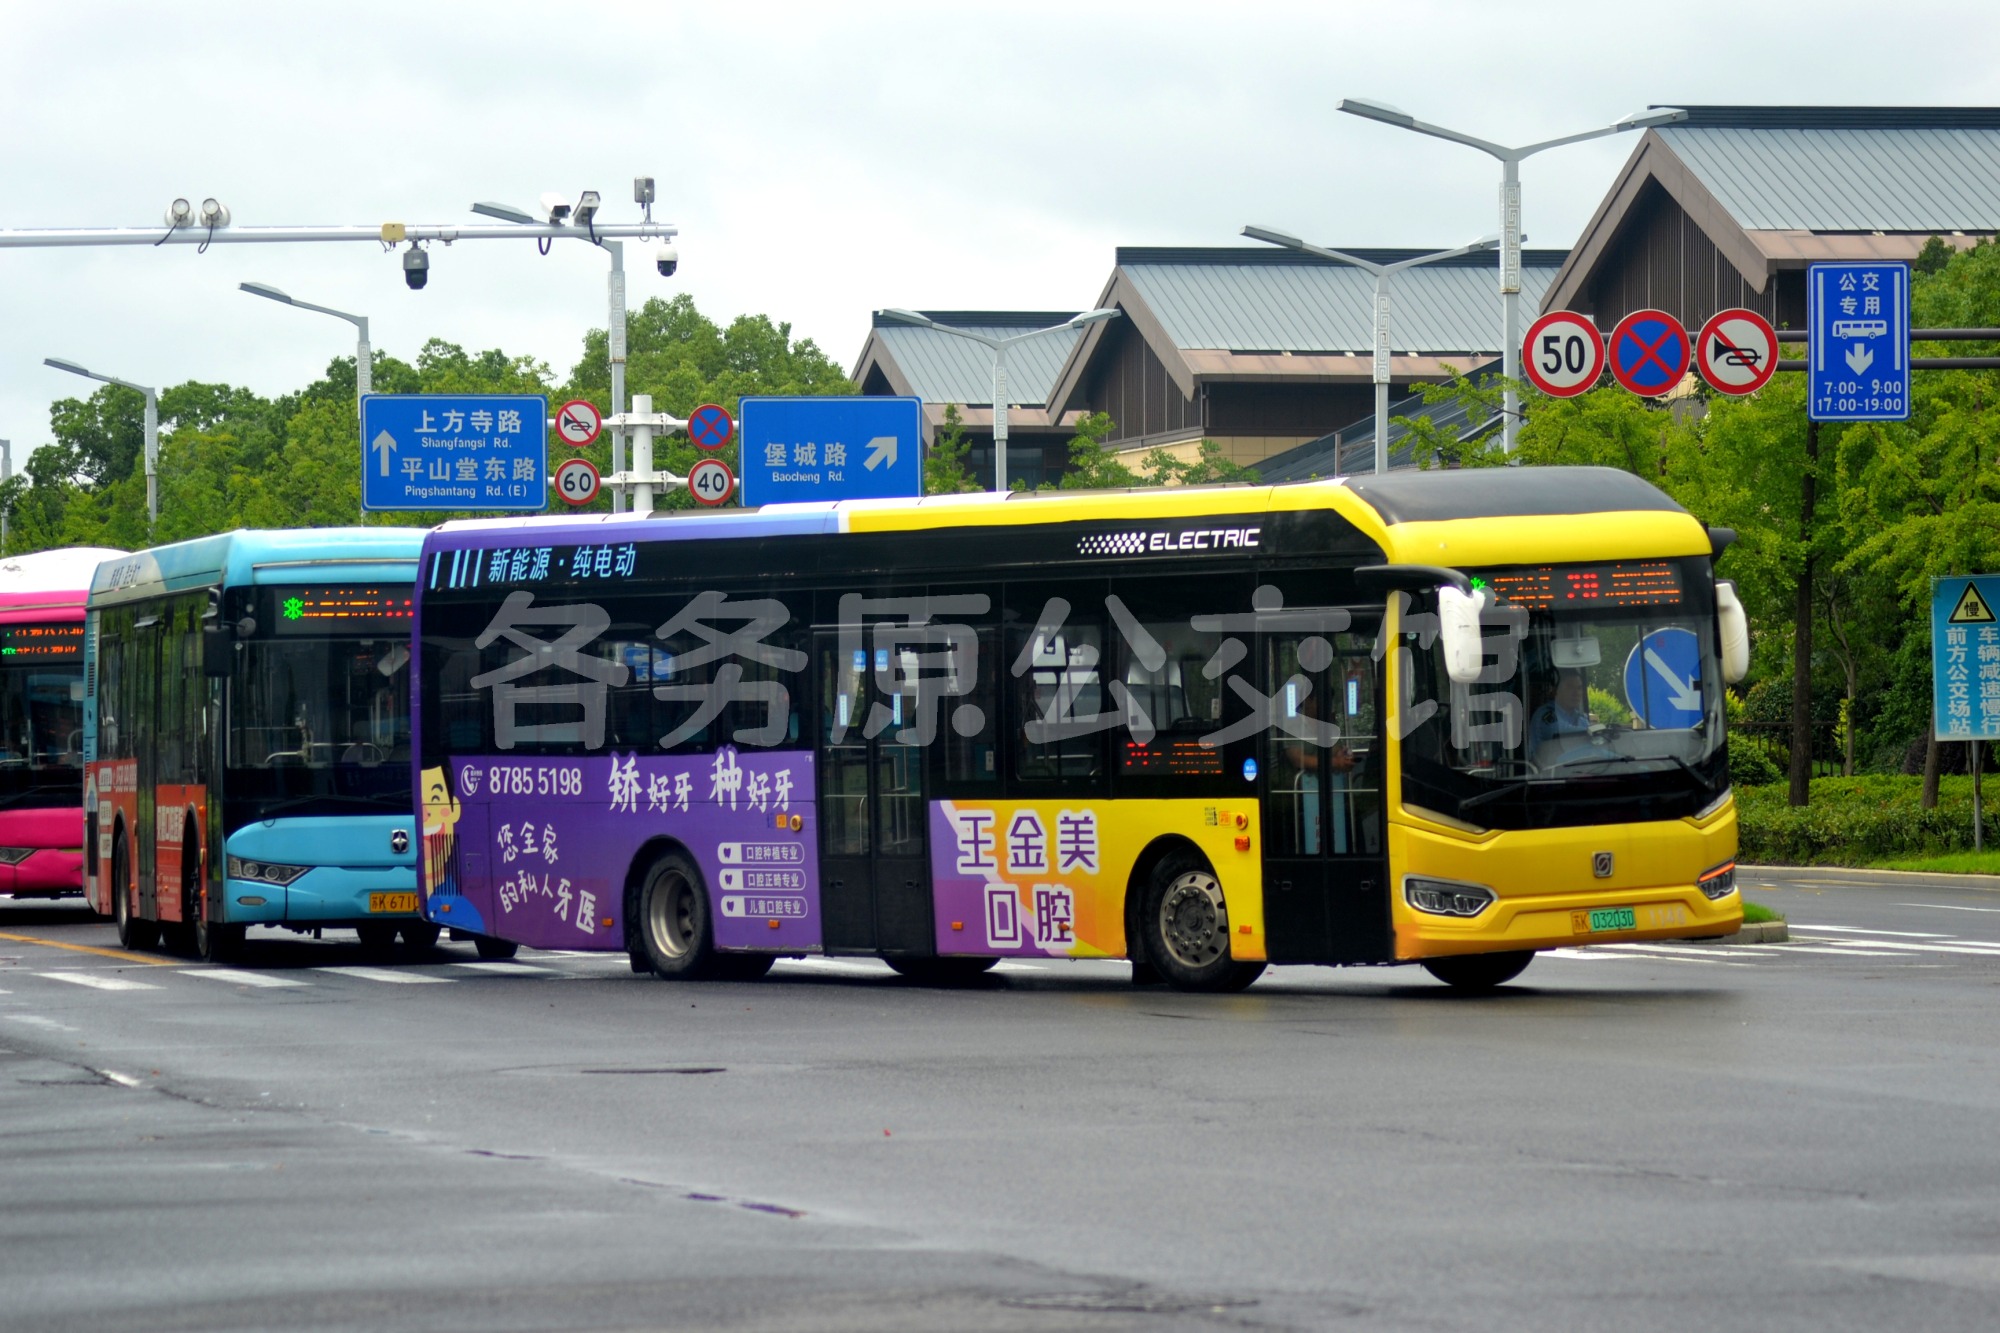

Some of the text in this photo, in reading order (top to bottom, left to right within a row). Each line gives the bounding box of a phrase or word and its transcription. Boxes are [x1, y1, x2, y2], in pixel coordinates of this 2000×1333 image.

[1839, 272, 1879, 292] 公交
[1839, 296, 1880, 315] 专用
[1541, 335, 1586, 375] 50
[1871, 379, 1902, 395] 9:00
[414, 409, 522, 434] 上方寺路
[421, 437, 512, 450] Shangfangsi Rd.
[764, 442, 847, 467] 堡城路
[400, 457, 536, 482] 平山堂东路
[772, 471, 845, 484] Baocheng Rd.
[405, 485, 527, 498] Pingshantang Rd. (E)
[563, 472, 592, 493] 60
[697, 472, 725, 493] 40
[1149, 528, 1261, 551] ELECTRIC
[1964, 602, 1980, 617] 慢
[1945, 627, 1971, 736] 前方公交场站
[1977, 626, 2000, 735] 车辆减速慢行
[489, 766, 534, 794] 8785
[538, 767, 583, 795] 5198
[608, 750, 794, 814] 矫好牙 种好牙
[497, 821, 559, 865] 您全家
[746, 846, 799, 860] 口腔种植专业
[958, 815, 1096, 869] 王金美
[747, 873, 800, 887] 口腔正畸专业
[499, 869, 597, 935] 的私人牙医
[750, 900, 802, 915] 儿童口腔专业
[988, 890, 1073, 942] 口腔
